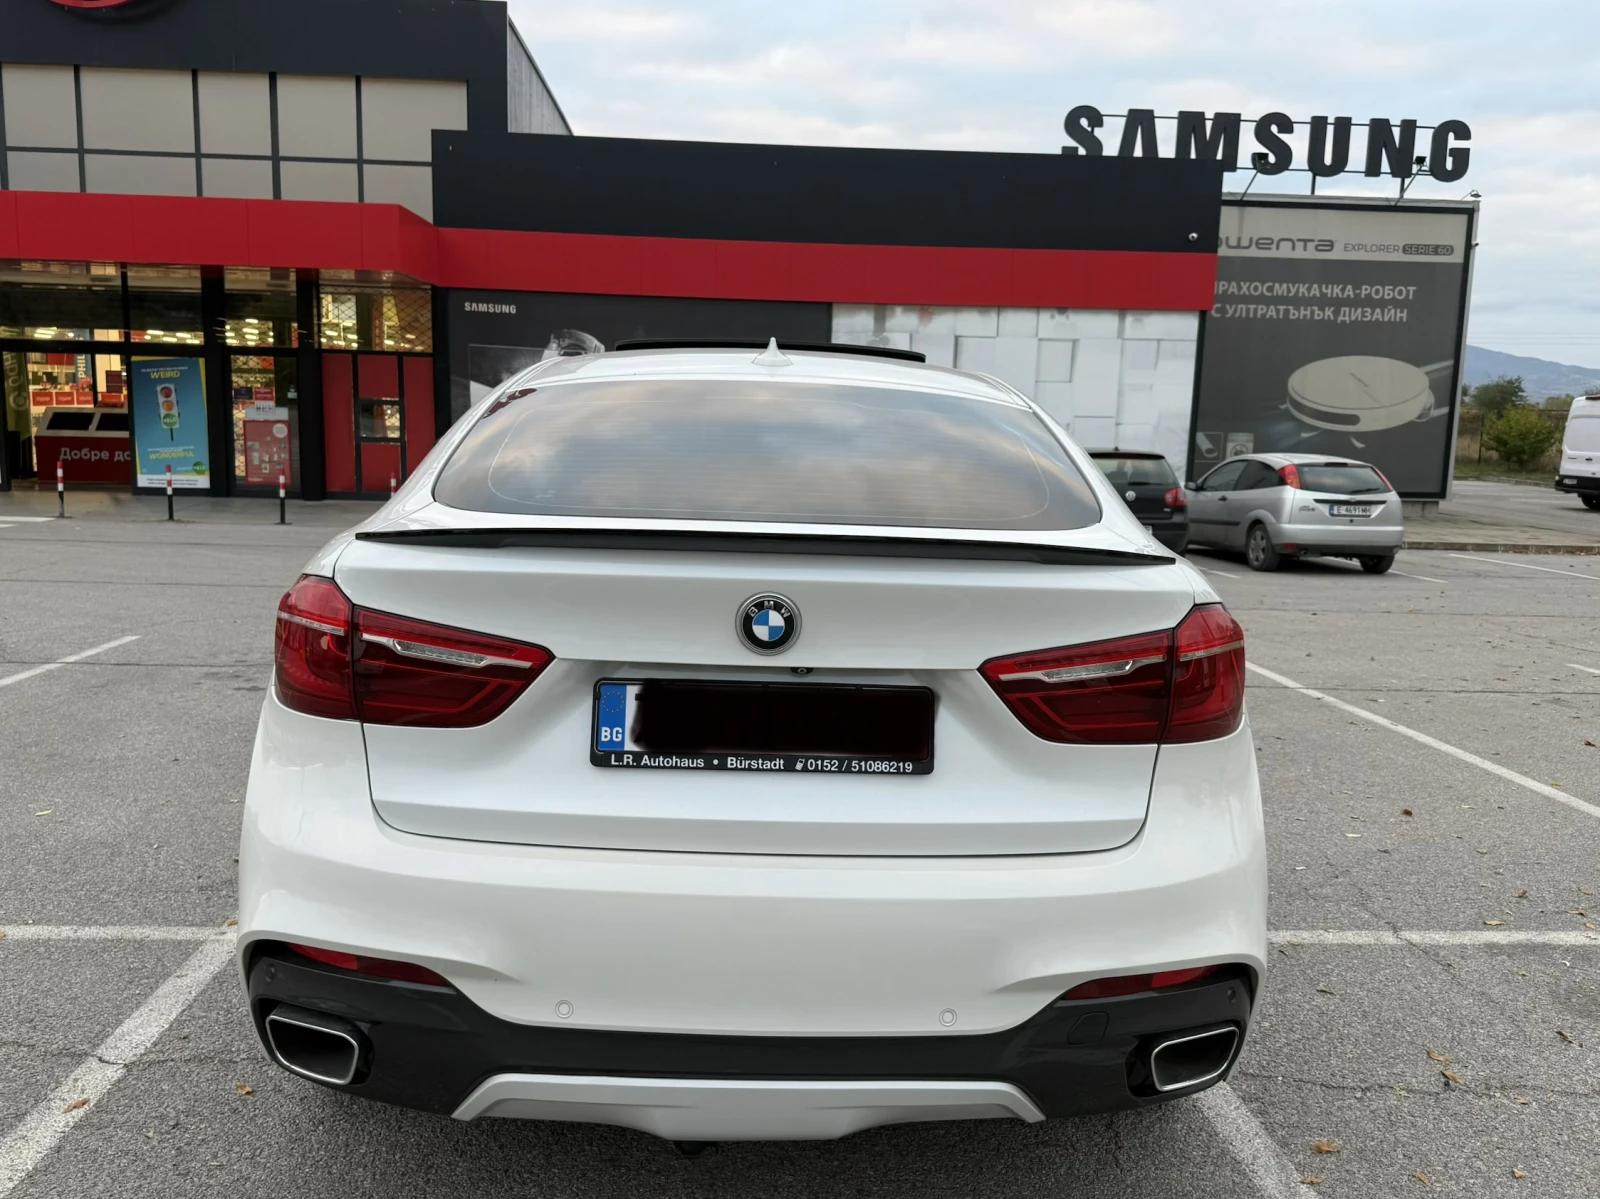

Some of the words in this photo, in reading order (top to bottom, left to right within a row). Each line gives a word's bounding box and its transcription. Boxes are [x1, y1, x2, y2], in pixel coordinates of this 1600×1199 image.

[1062, 105, 1472, 182] SAMSUNG
[1218, 235, 1335, 252] wenta
[1343, 243, 1400, 254] EXPLORER
[1405, 245, 1435, 254] SERIE
[1438, 246, 1451, 255] 60
[464, 302, 517, 314] SAMSUNG
[1211, 304, 1221, 317] С
[1226, 304, 1334, 320] УЛТРАТЪНЪК
[1337, 306, 1408, 323] ДИЗАЙН
[150, 371, 180, 379] WEIRD
[60, 448, 110, 461] Добре
[748, 600, 790, 618] BMW
[601, 727, 623, 742] BG
[611, 754, 636, 766] L.R.
[640, 755, 704, 768] Autohaus
[727, 756, 784, 770] Bürstadt
[807, 759, 838, 771] 0152
[851, 760, 912, 773] 51086219
